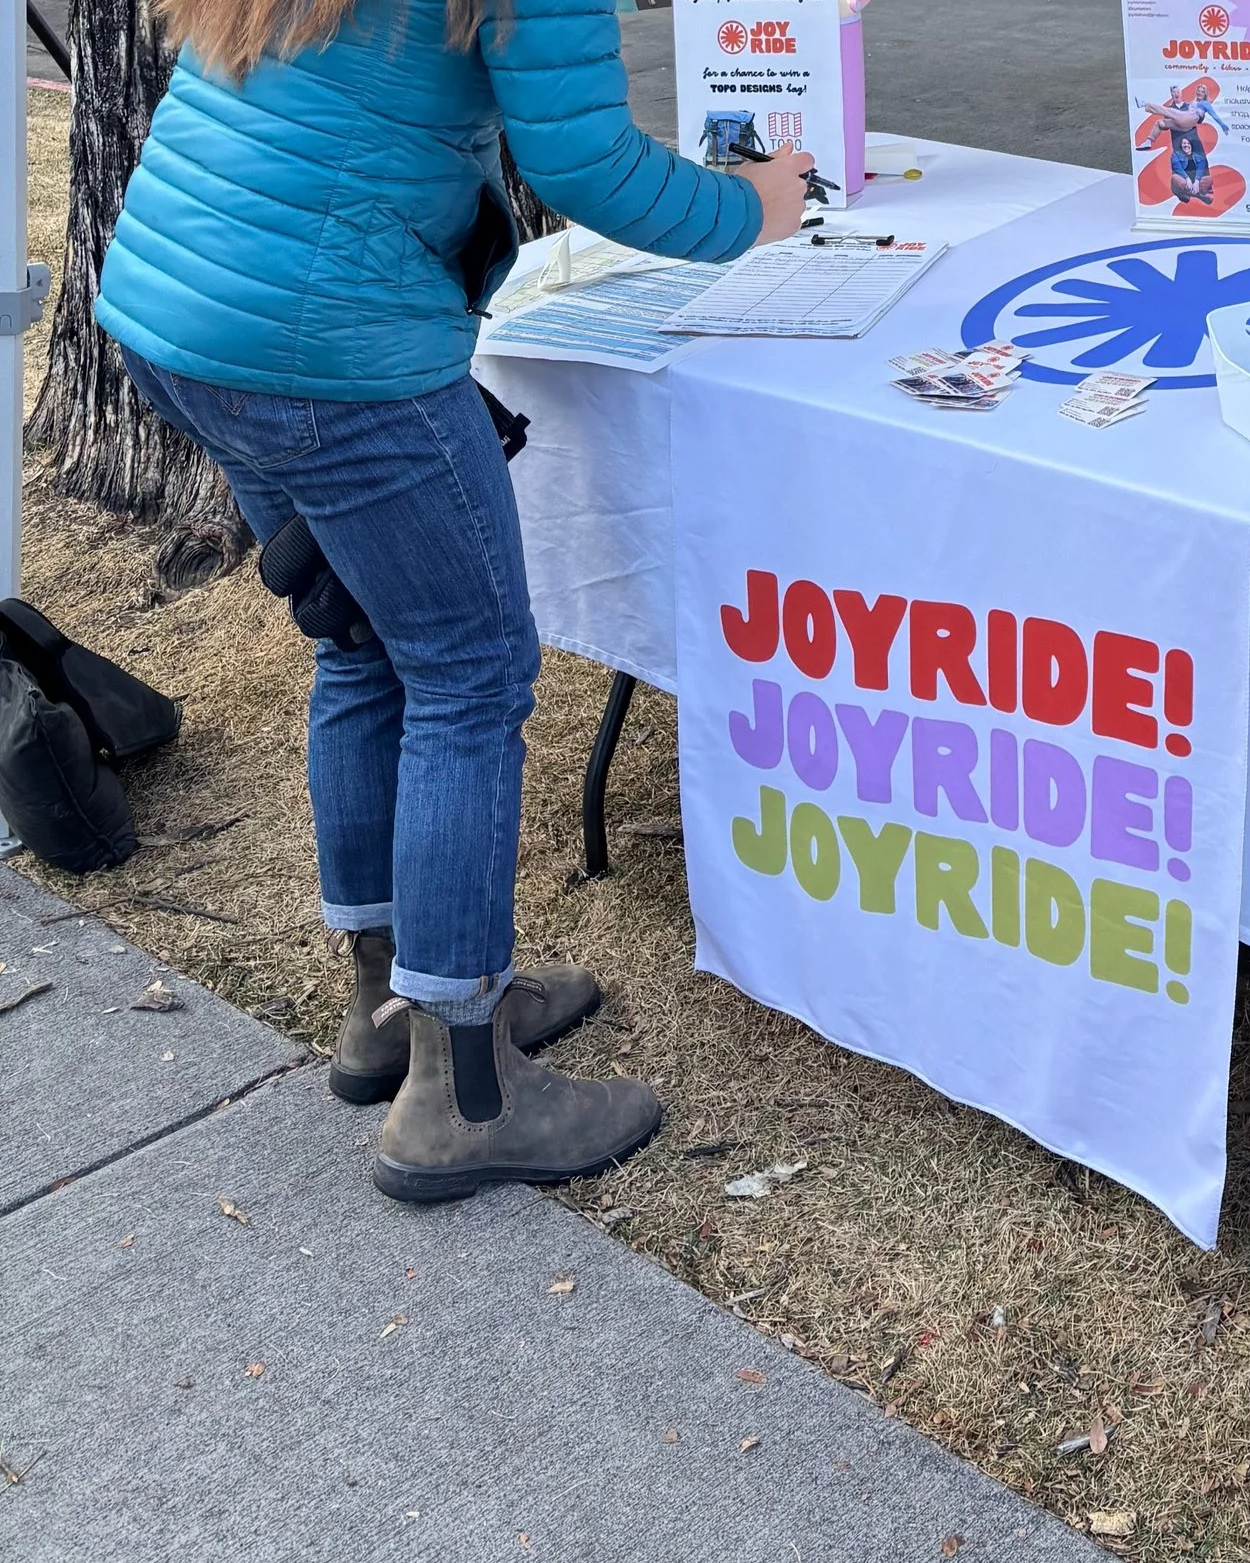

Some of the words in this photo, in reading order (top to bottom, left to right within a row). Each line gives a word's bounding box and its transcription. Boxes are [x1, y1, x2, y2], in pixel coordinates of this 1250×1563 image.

[750, 22, 790, 38] JOY
[750, 37, 796, 54] RIDE
[703, 67, 719, 79] for
[730, 68, 764, 78] chance
[766, 68, 777, 78] to
[779, 69, 801, 78] win
[1164, 63, 1209, 73] community
[1221, 63, 1242, 71] bikes
[710, 84, 736, 93] TOPO
[740, 84, 783, 93] DESIGNS
[786, 83, 807, 96] bag!
[720, 568, 1194, 757] JOYRIDE!
[729, 678, 1193, 882] JOYRIDE!
[731, 785, 1192, 1005] JOYRIDE!
